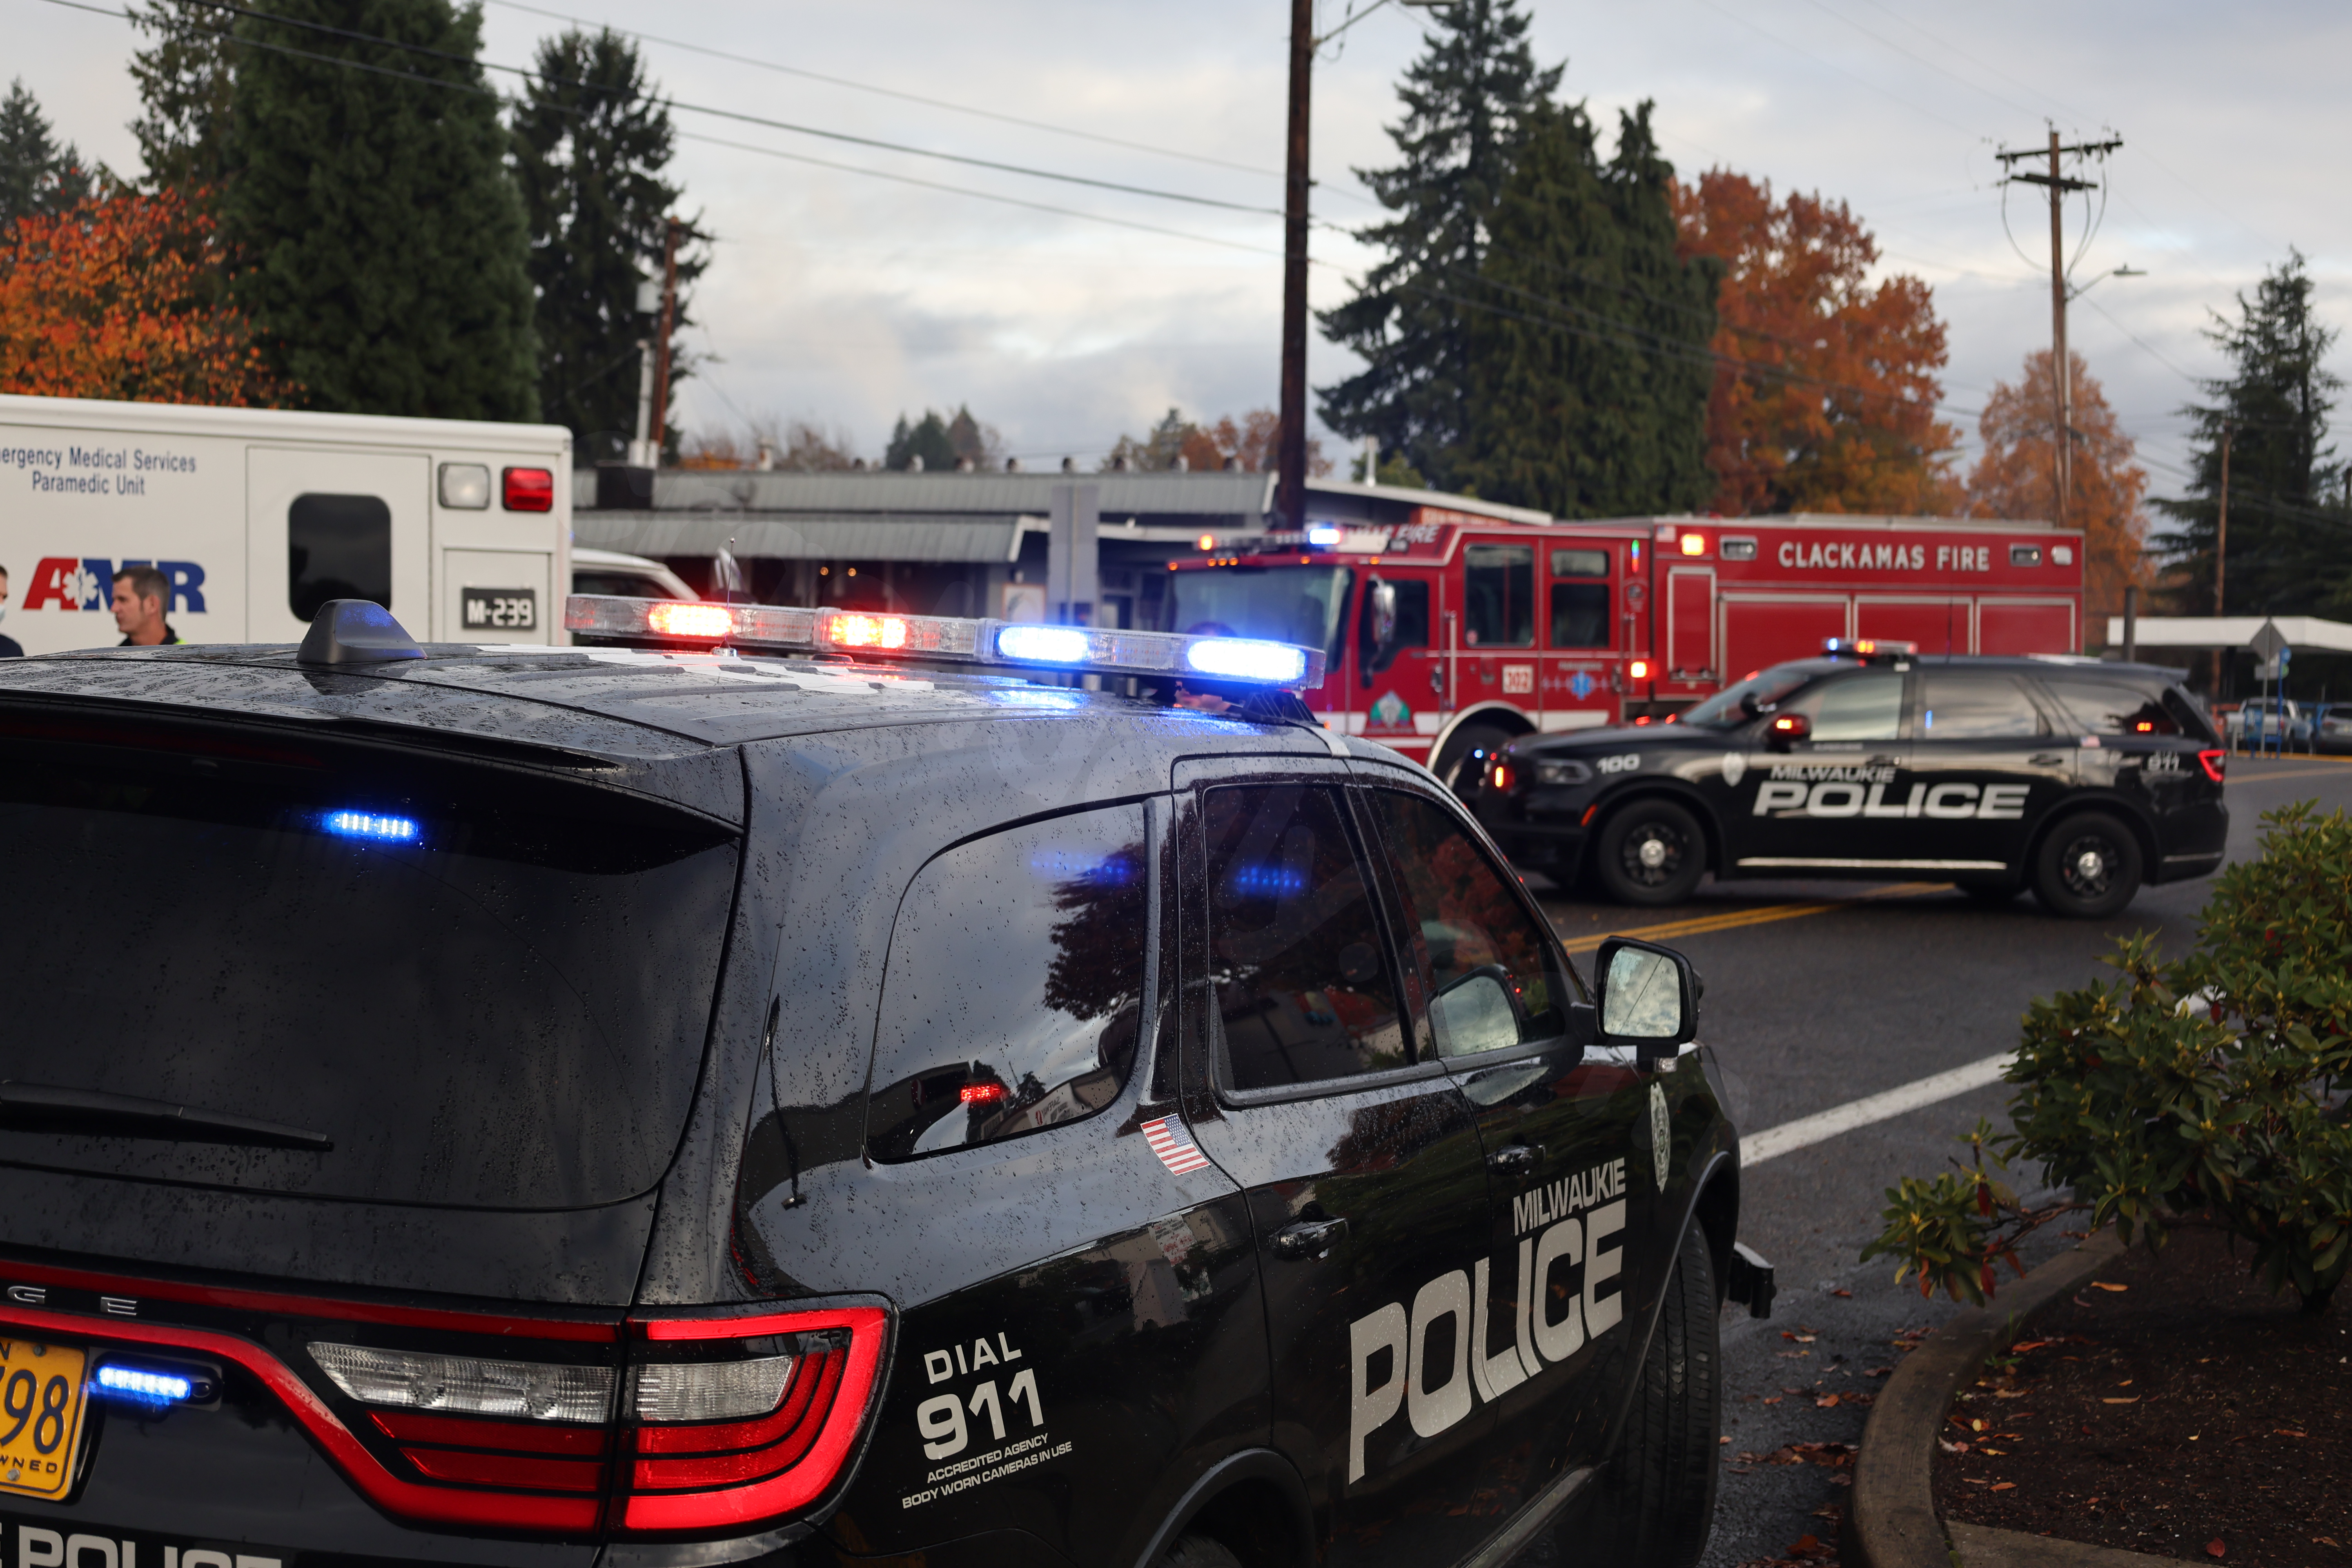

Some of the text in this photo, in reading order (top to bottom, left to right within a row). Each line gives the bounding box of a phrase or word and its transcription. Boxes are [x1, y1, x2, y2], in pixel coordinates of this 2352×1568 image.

[0, 446, 196, 473] ergency Medical Services
[33, 471, 145, 495] Paramedic Unit
[1778, 541, 1990, 572] CLACKAMAS FIRE
[467, 598, 533, 626] M-239
[1597, 753, 1641, 775] 100
[1770, 765, 1896, 783] MILWAUKIE
[1752, 780, 2031, 819] POLICE
[1514, 1157, 1626, 1236] MILWAUKIE
[924, 1332, 1022, 1384] DIAL
[1349, 1199, 1626, 1485] POLICE
[0, 1366, 70, 1454] 98
[917, 1368, 1044, 1460] 911
[902, 1441, 1073, 1509] BODY WORN CAMERAS IN USE
[927, 1433, 1048, 1483] ACCREDITED AGENCY
[19, 1525, 282, 1568] POL
